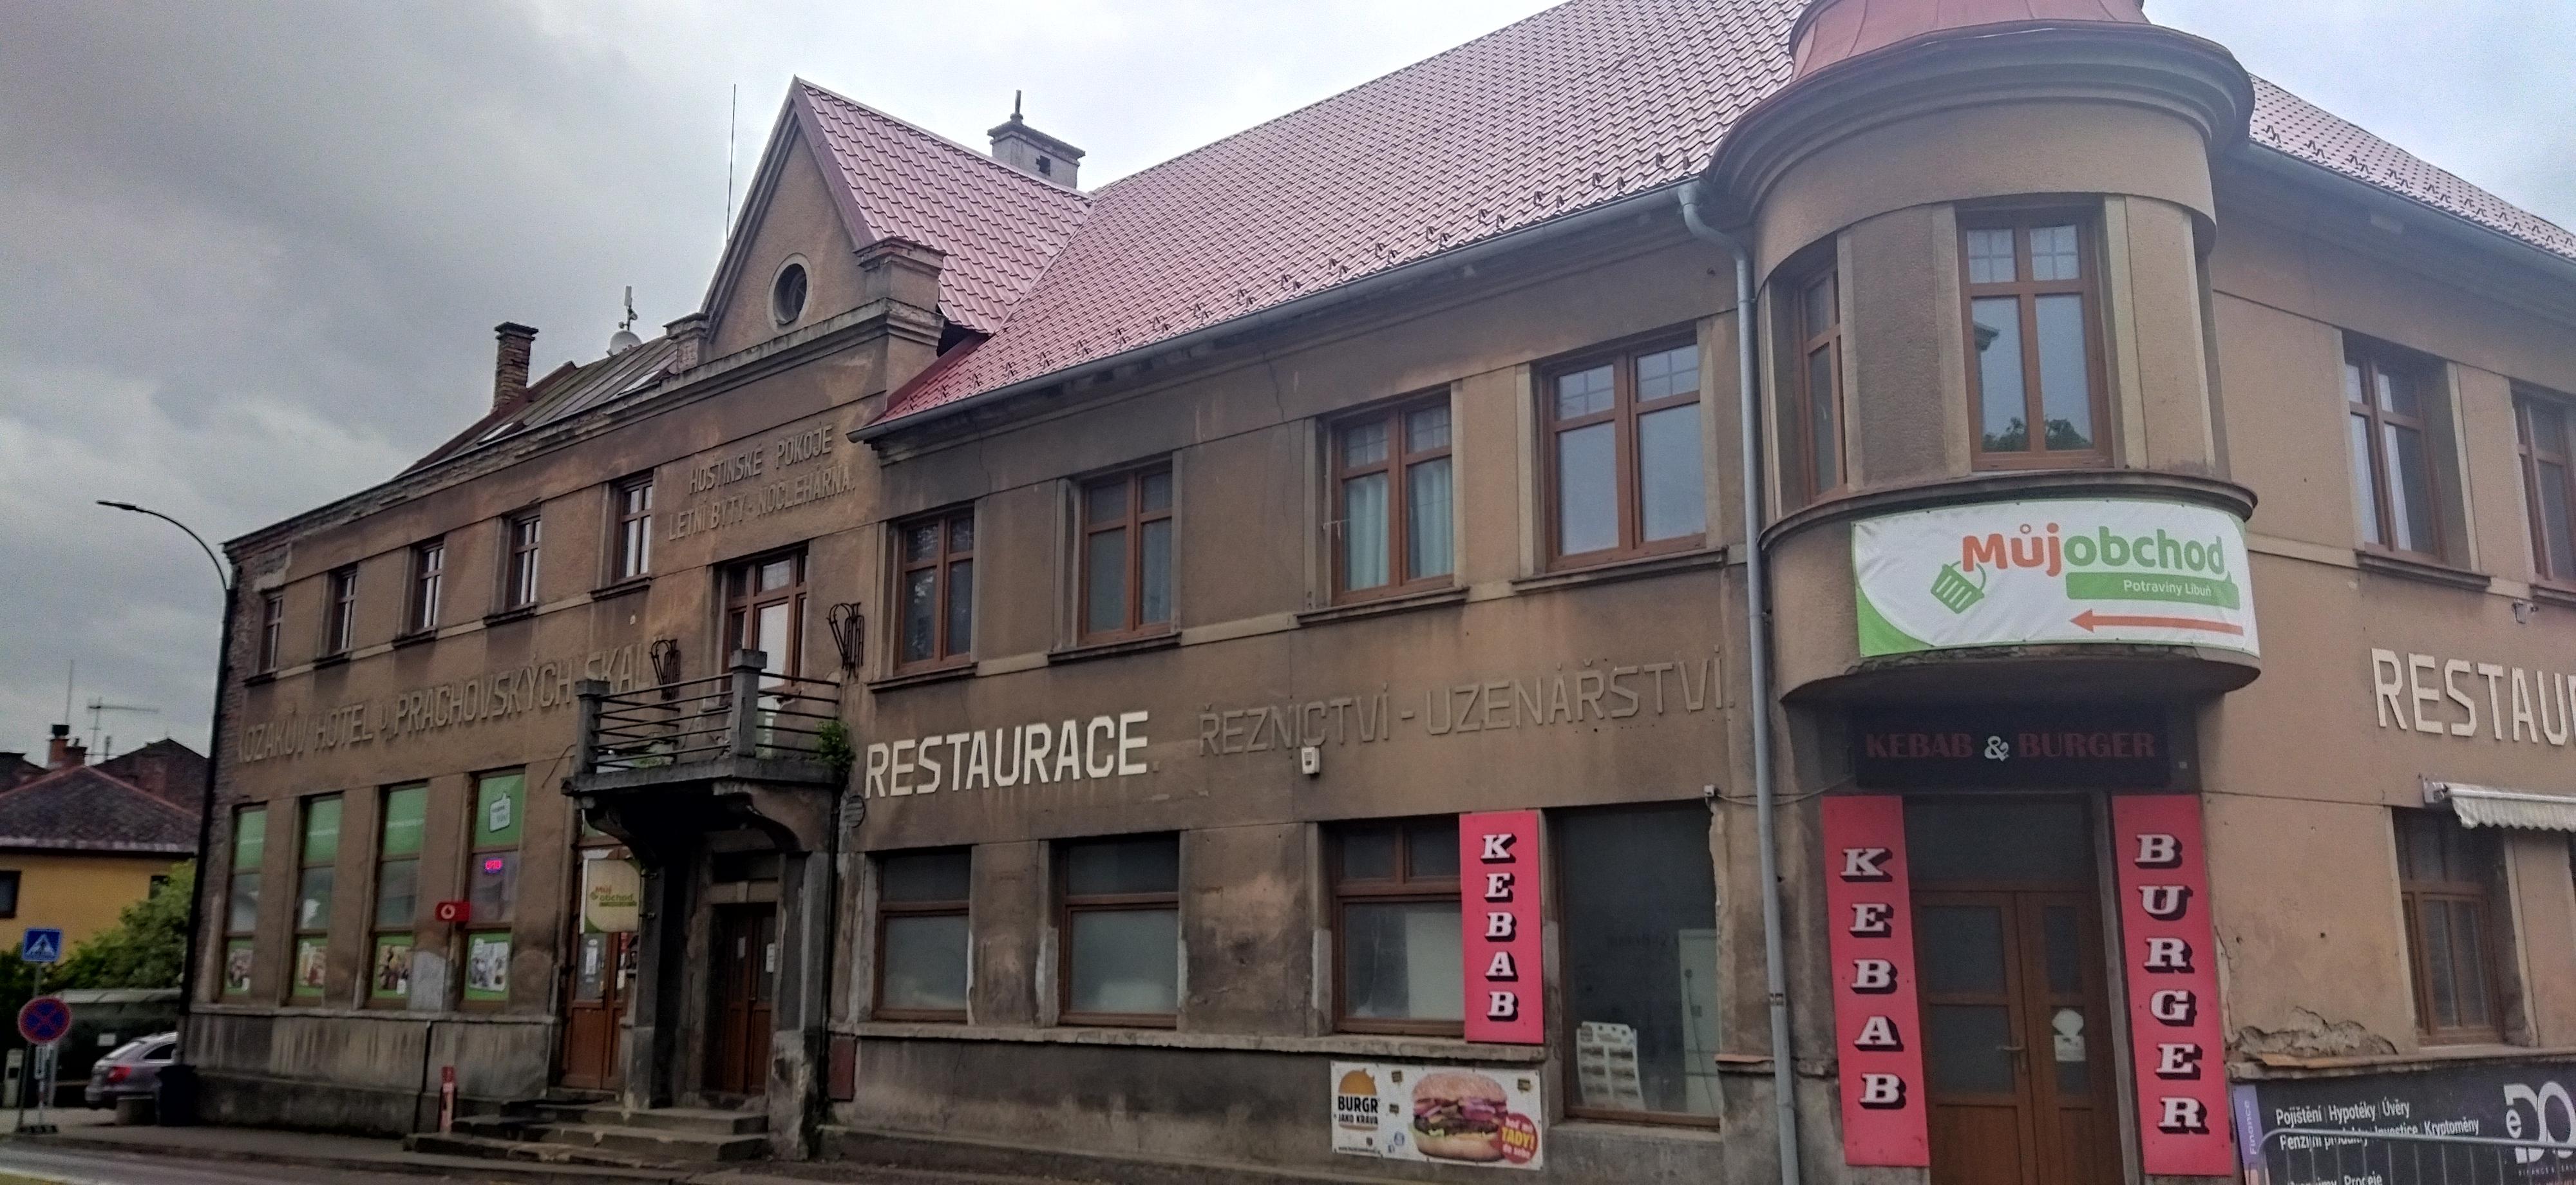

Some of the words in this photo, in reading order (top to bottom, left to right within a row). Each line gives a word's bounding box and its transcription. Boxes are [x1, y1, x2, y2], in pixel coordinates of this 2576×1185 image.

[688, 442, 763, 494] HOSTINSKÉ
[775, 424, 833, 469] POKOJE
[668, 500, 707, 541] LETNÍ
[711, 491, 748, 530] BYTY
[2123, 580, 2183, 596] Potraviny
[1199, 681, 1389, 757] ŘEZNICTVÍ
[2371, 648, 2576, 746] RESTAU
[314, 703, 374, 751] HOTEL
[865, 710, 1148, 799] RESTAURACE
[1868, 732, 1974, 759] KEBAB
[1984, 735, 2009, 762] &
[2018, 731, 2155, 759] BURGER
[1481, 833, 1519, 1022] KEBAB
[1840, 848, 1906, 1110] KEBAB
[2134, 834, 2210, 1133] BURGER
[1338, 1095, 1378, 1113] BURGR
[2244, 1099, 2257, 1155] Finance
[2275, 1104, 2322, 1128] Pojištění
[2328, 1101, 2376, 1125] Hypotéky
[2382, 1096, 2410, 1119] Úvěry
[2424, 1117, 2479, 1137] Kryptoměny
